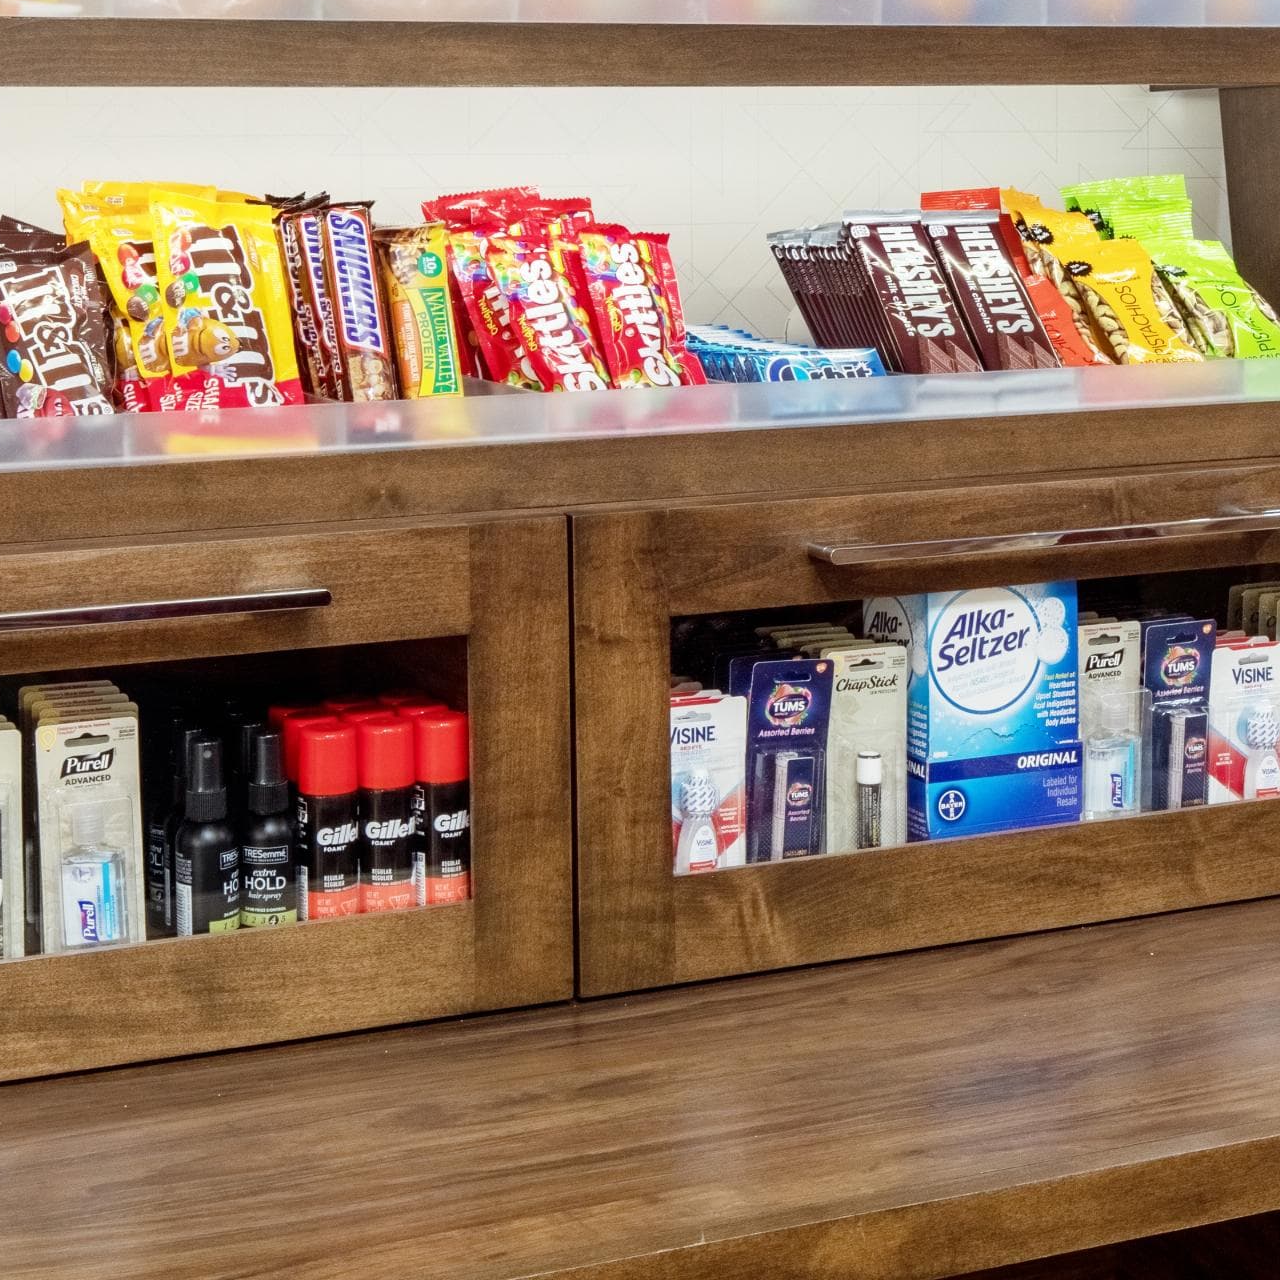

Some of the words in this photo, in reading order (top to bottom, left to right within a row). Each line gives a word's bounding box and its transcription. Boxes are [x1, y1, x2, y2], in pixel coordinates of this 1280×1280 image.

[330, 213, 382, 350] SNICKERS
[875, 225, 956, 339] HERSHEY'S
[954, 225, 1036, 335] HERSHEY'S
[971, 292, 995, 334] chocolate
[1114, 285, 1173, 355] PISTACHIOS
[416, 311, 435, 370] PROTEIN
[422, 290, 448, 342] NATURE
[438, 341, 458, 394] VALLEY
[868, 611, 903, 633] Alka-
[942, 608, 1015, 644] Alka-
[936, 626, 1031, 673] Seltzer
[1089, 651, 1121, 670] Purell
[1168, 661, 1195, 673] TUMS
[835, 673, 899, 693] ChapStick
[1088, 669, 1122, 680] ADVANCED
[1232, 666, 1273, 685] VISINE
[772, 700, 806, 712] TUMS
[1059, 716, 1076, 726] Aches
[758, 727, 790, 738] Assorted
[791, 726, 816, 737] Berries
[65, 750, 109, 774] Purell
[1016, 750, 1078, 770] ORIGINAL
[64, 773, 112, 786] ADVANCED
[1042, 776, 1066, 787] Labeled
[1067, 775, 1077, 784] for
[790, 791, 809, 799] TUMS
[1047, 785, 1078, 798] Individual
[1111, 775, 1122, 806] Purell
[1056, 796, 1078, 807] Resale
[316, 822, 358, 846] Gille
[364, 814, 416, 839] Gillet
[252, 868, 277, 877] extra
[244, 876, 287, 891] HOLD
[83, 902, 96, 938] Purell
